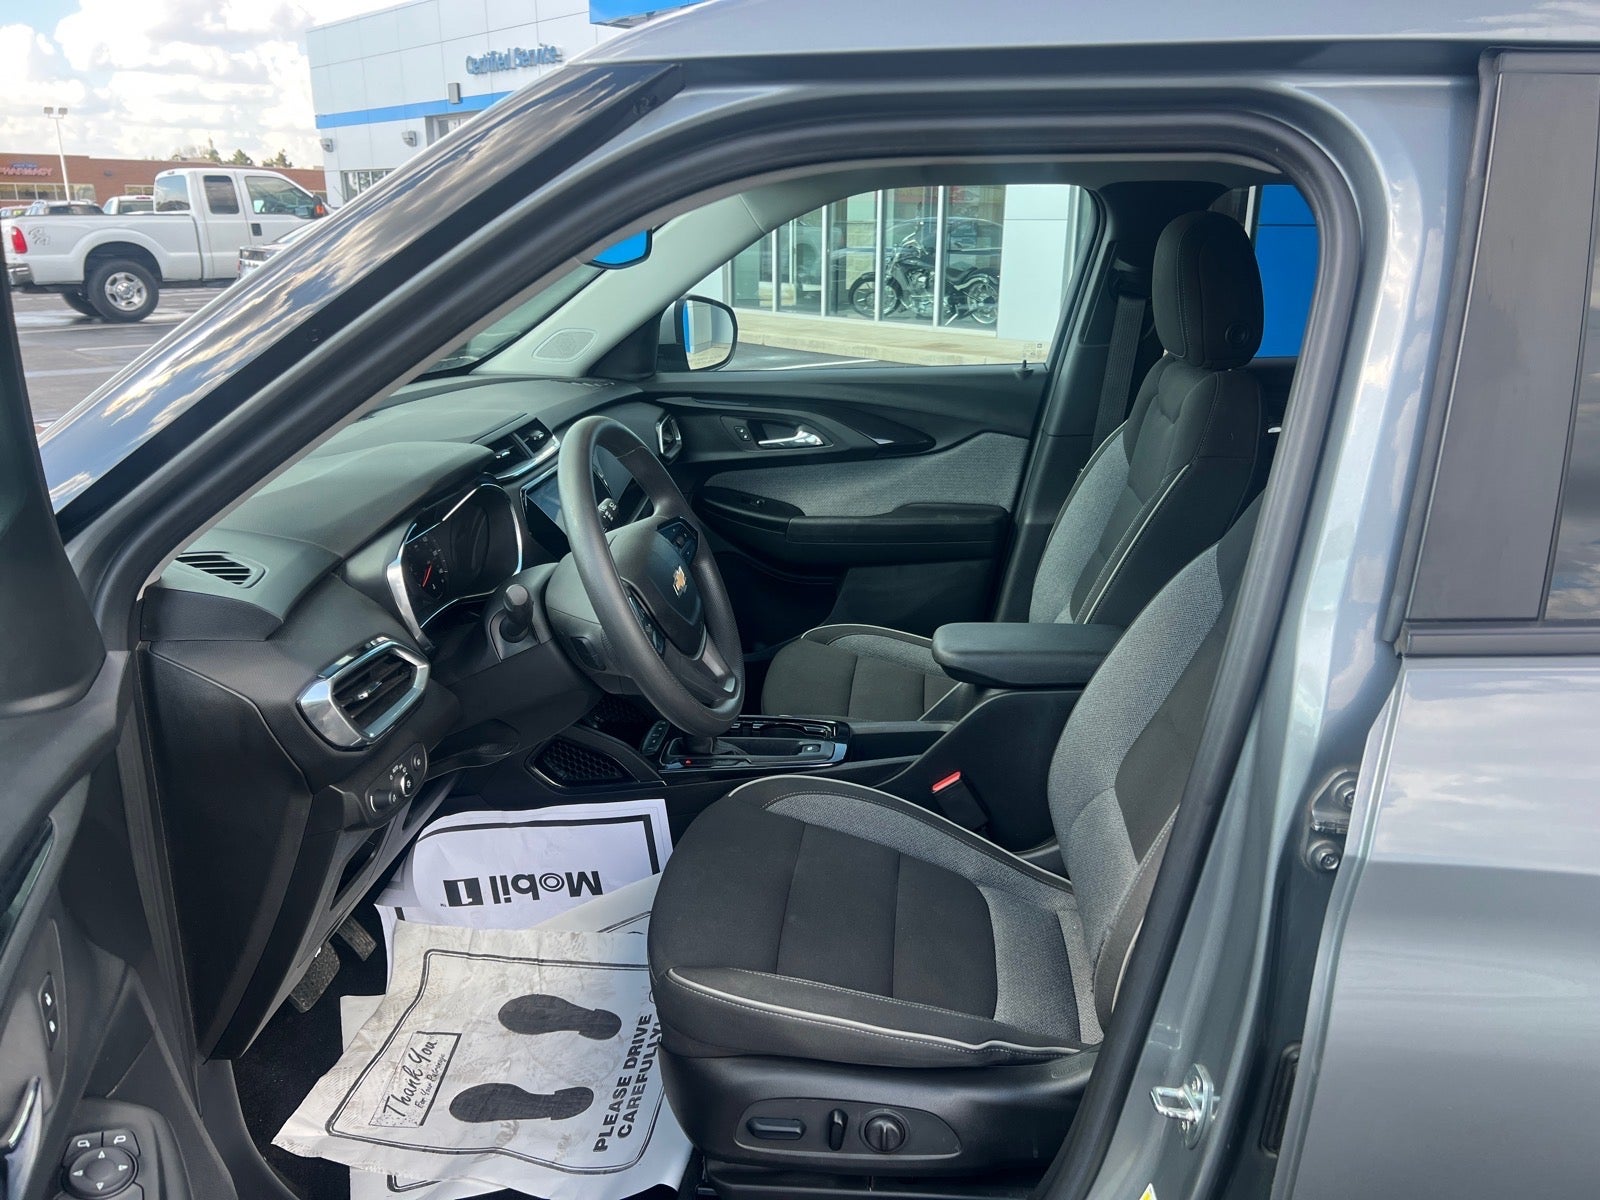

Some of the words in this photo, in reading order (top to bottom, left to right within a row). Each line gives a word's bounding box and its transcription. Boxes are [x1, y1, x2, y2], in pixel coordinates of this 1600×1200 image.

[466, 48, 514, 75] Certified
[515, 44, 559, 67] Service
[488, 870, 603, 904] Mobil
[383, 1065, 424, 1117] Thank
[408, 1041, 438, 1064] You
[593, 1075, 632, 1152] PLEASE
[623, 1014, 652, 1070] DRIVE
